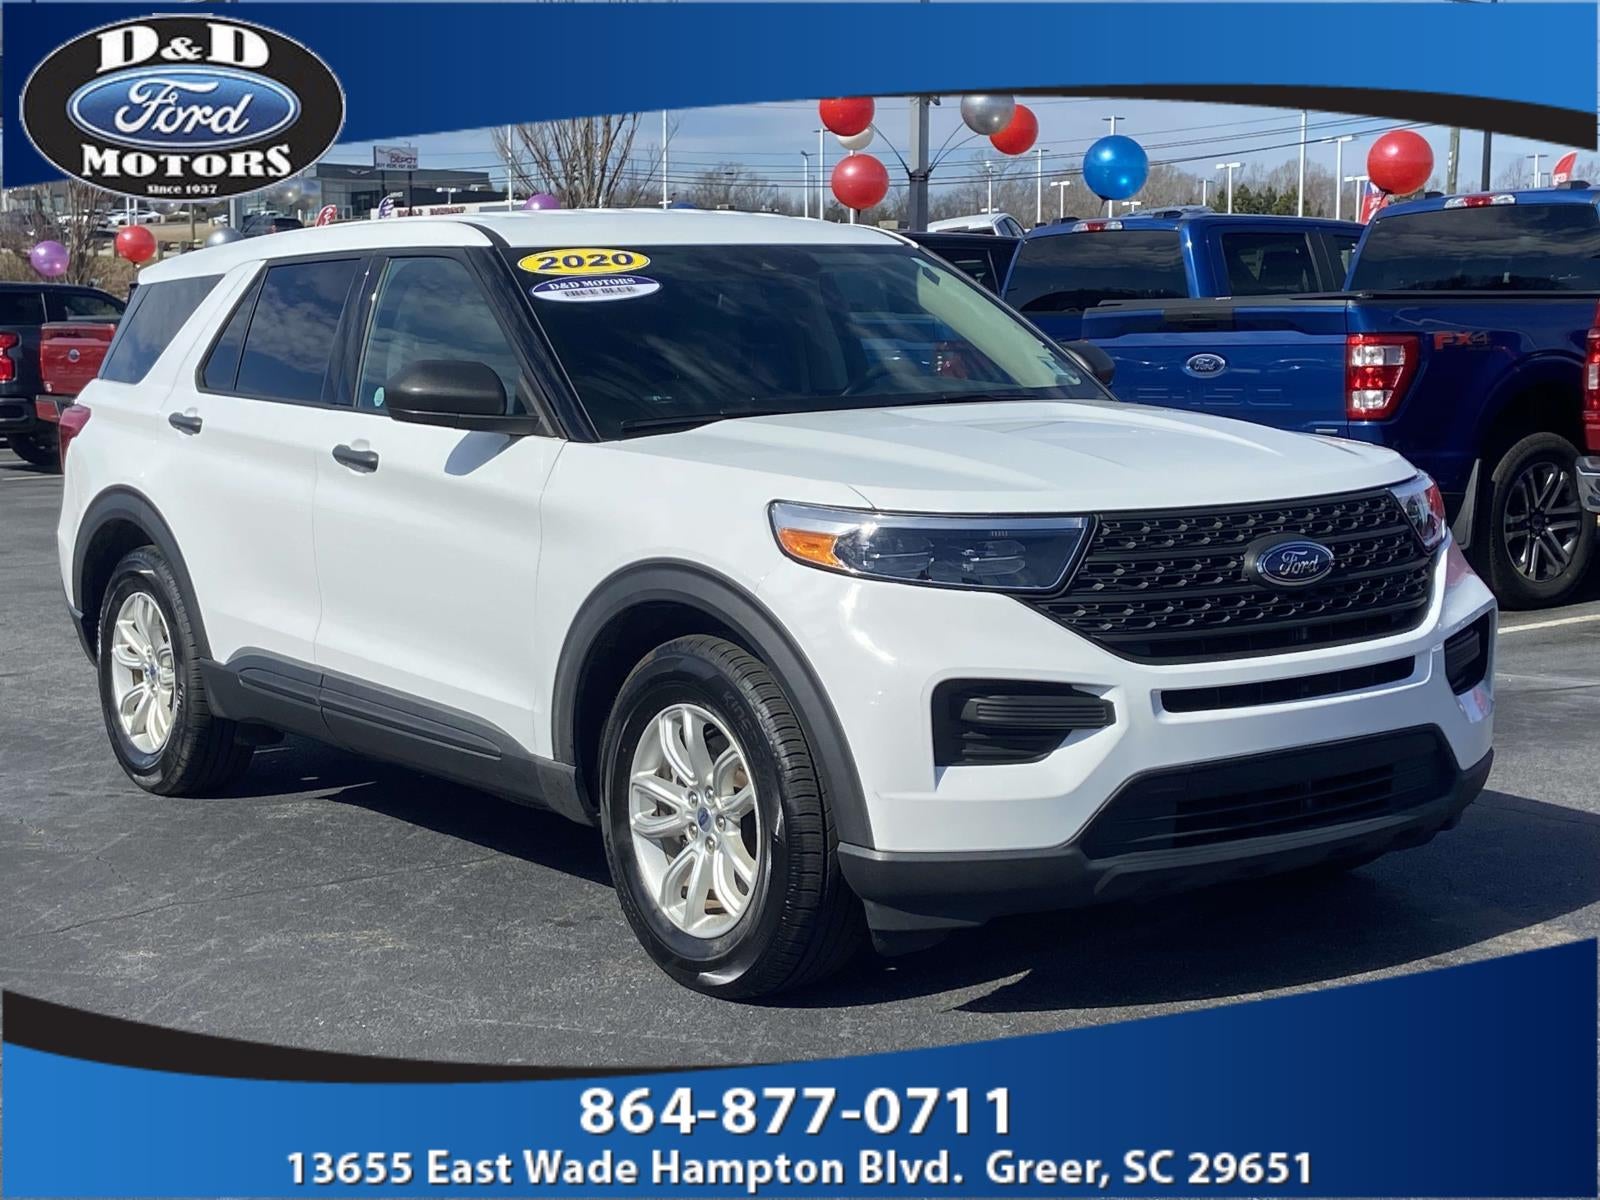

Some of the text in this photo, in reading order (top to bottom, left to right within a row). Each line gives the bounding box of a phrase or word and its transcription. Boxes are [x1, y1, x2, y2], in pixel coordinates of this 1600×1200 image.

[536, 253, 634, 270] 2020
[549, 277, 636, 290] D&D MOTORS
[1194, 358, 1215, 370] Ford
[1279, 550, 1320, 576] Ford
